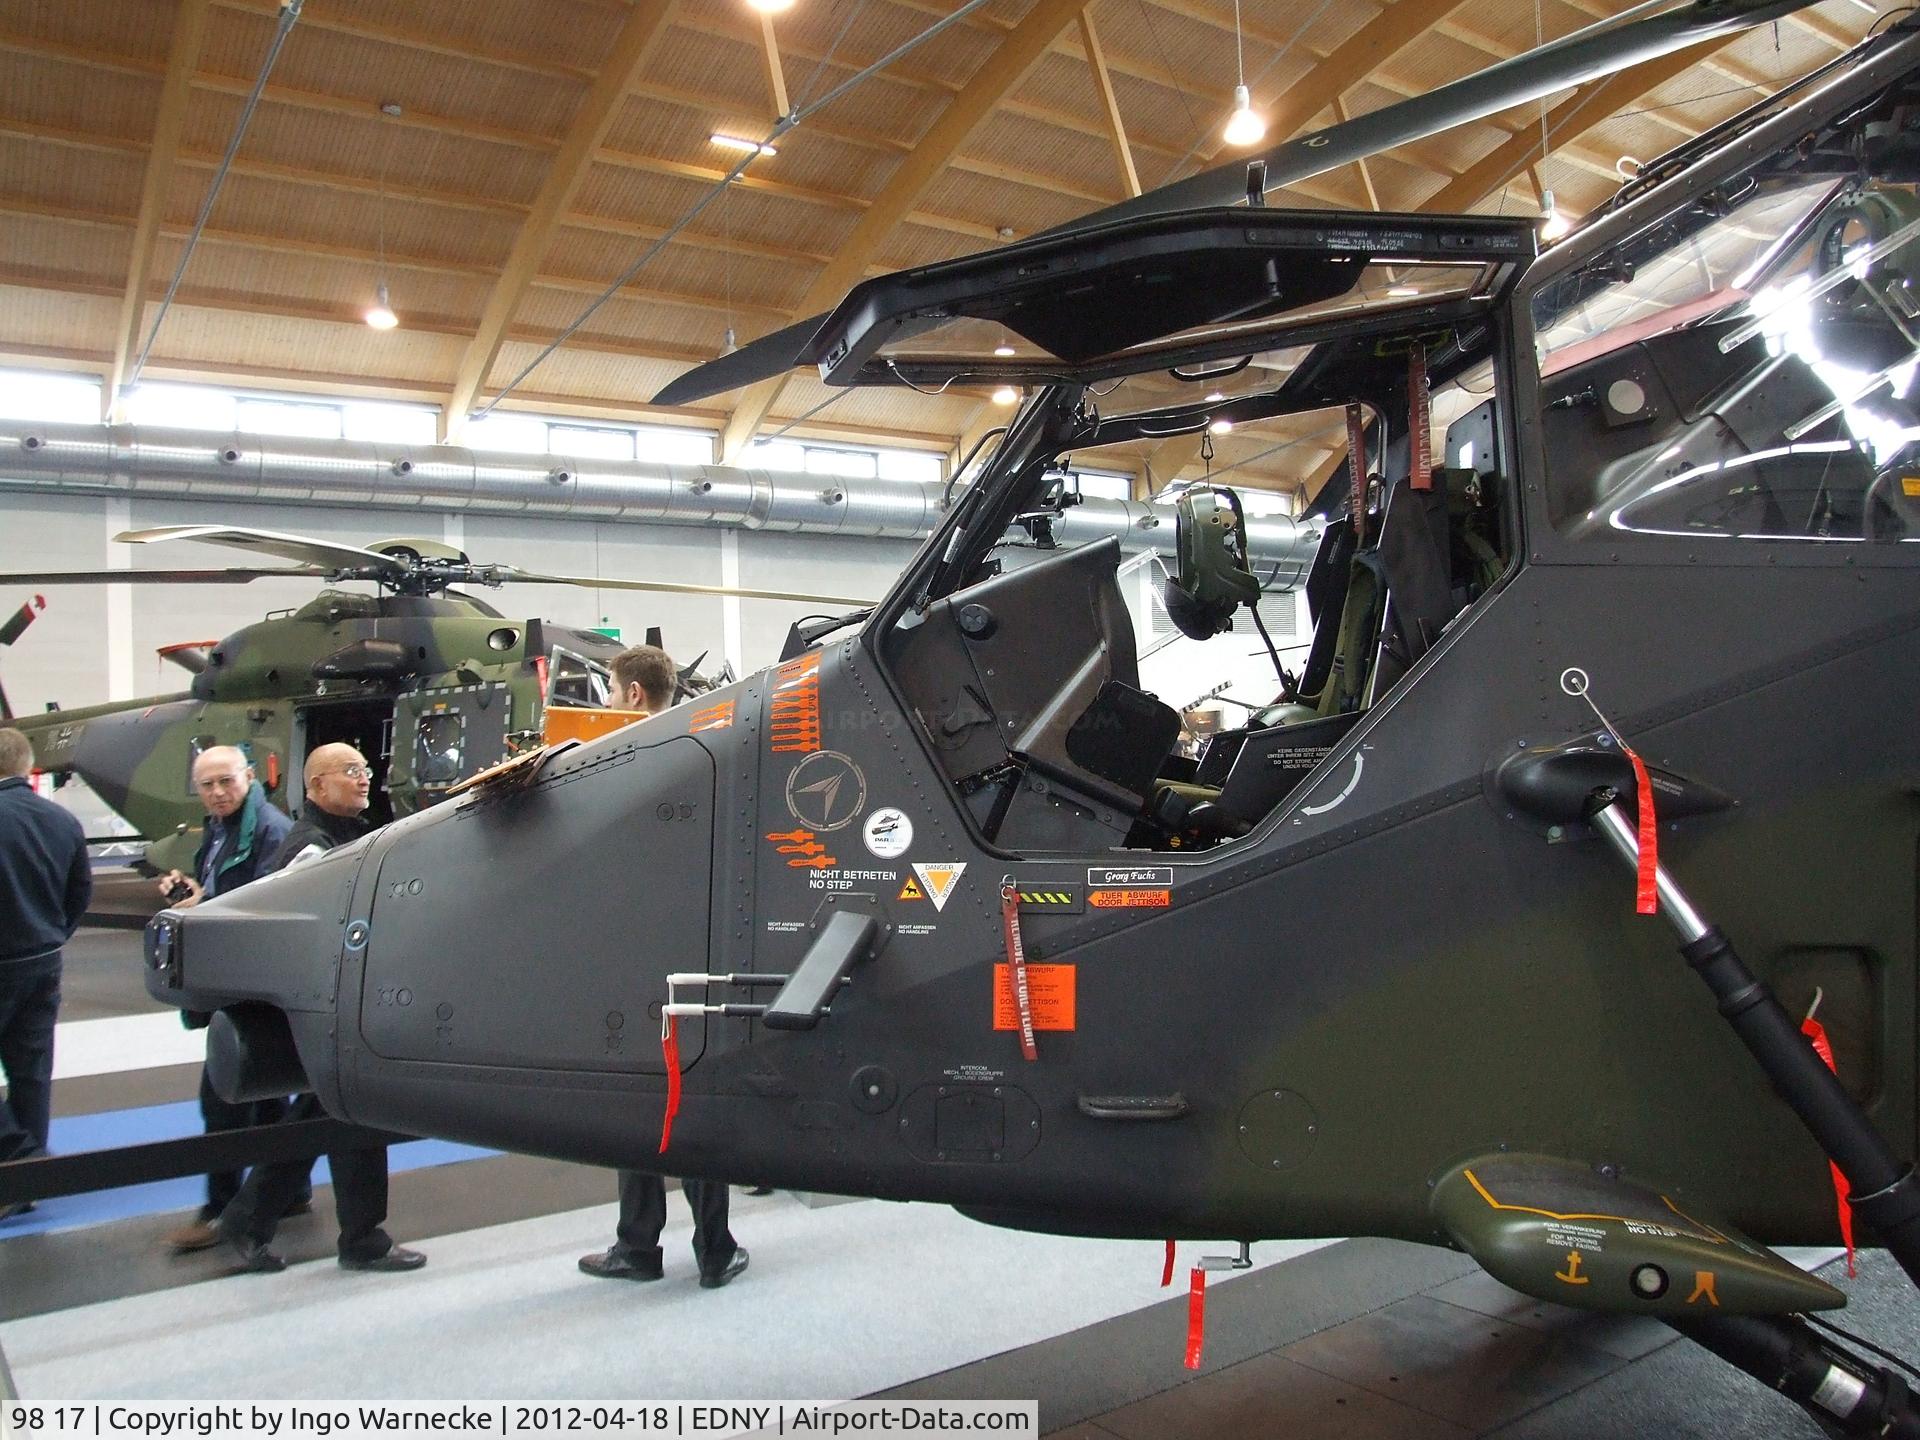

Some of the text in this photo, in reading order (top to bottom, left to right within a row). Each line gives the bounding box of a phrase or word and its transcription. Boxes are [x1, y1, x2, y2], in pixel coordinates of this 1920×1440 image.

[809, 869, 897, 881] NICHT BETRETEN
[1105, 870, 1156, 883] Georg Fuchs
[809, 880, 853, 890] NO STEP
[1127, 891, 1163, 899] ABWURF
[1126, 898, 1166, 906] JETTISON
[1628, 1225, 1646, 1234] NO
[1547, 1238, 1573, 1247] REMOVE
